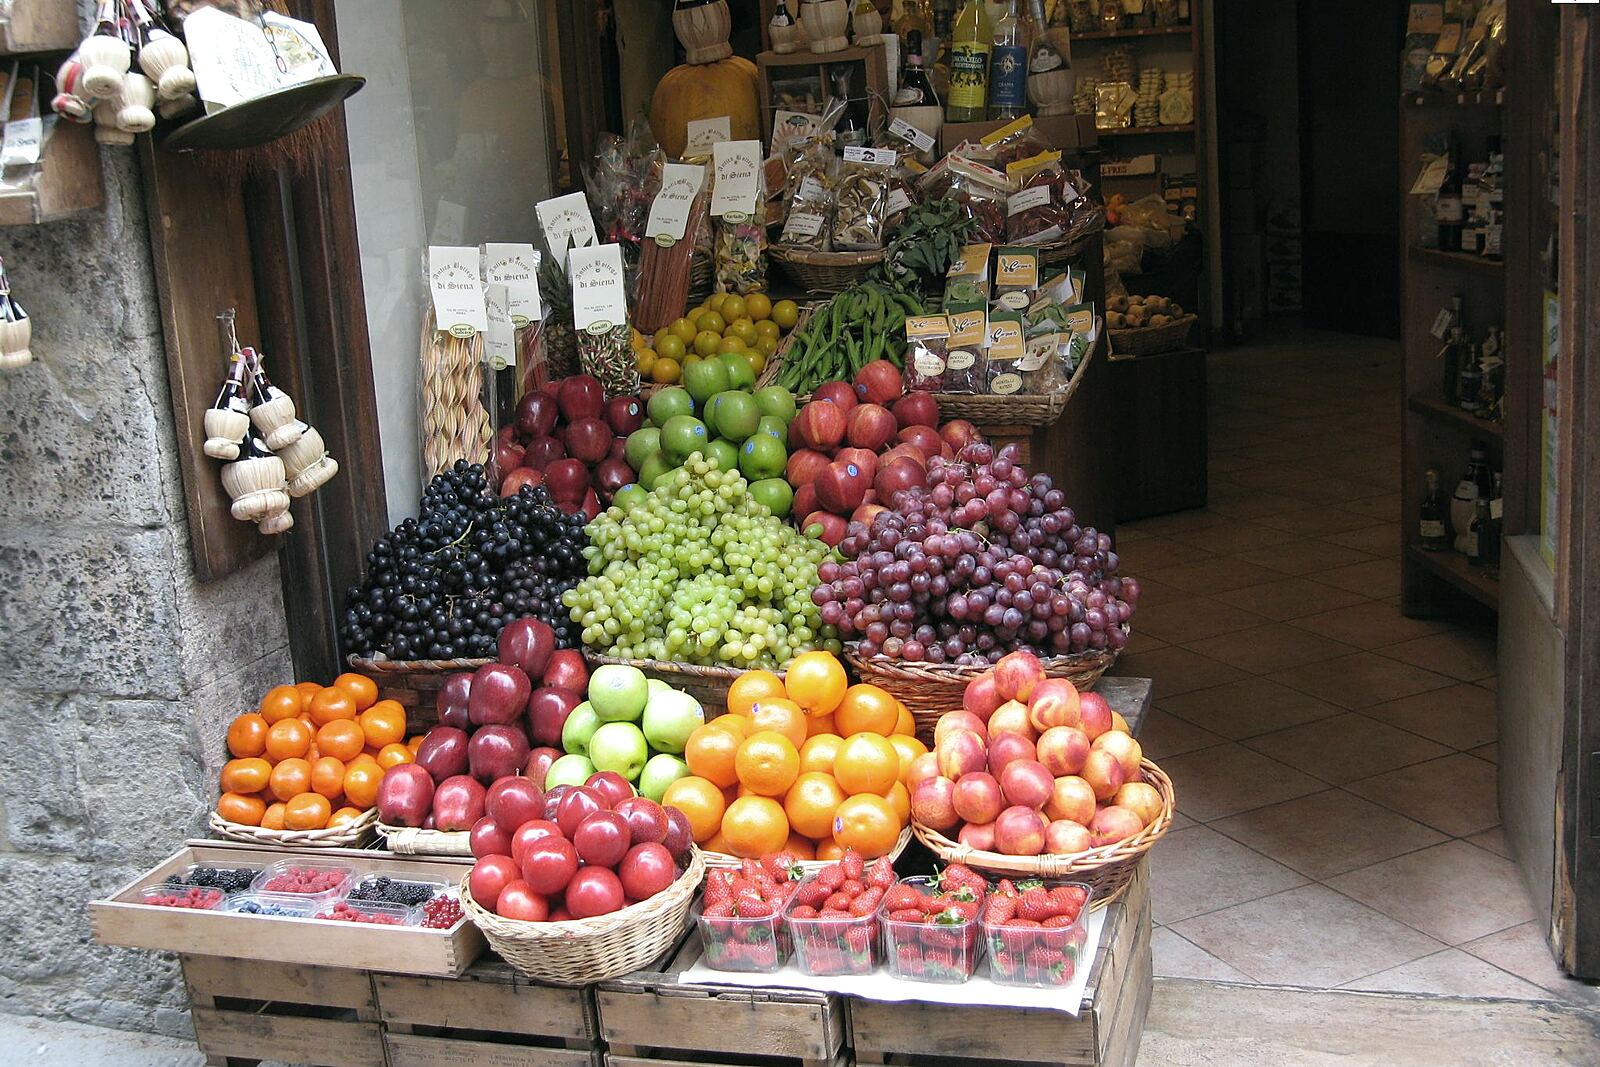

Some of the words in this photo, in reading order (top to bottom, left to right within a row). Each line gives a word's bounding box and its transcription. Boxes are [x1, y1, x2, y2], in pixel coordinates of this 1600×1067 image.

[730, 171, 751, 179] Siena
[668, 192, 688, 201] Siena
[553, 230, 561, 240] di
[432, 263, 451, 280] Antica
[453, 261, 476, 281] Bottega
[575, 263, 593, 280] Antica
[595, 260, 618, 277] Bottega
[503, 273, 529, 281] Siena
[437, 282, 446, 290] di
[447, 281, 474, 290] Siena
[580, 280, 588, 288] di
[589, 278, 615, 287] Siena
